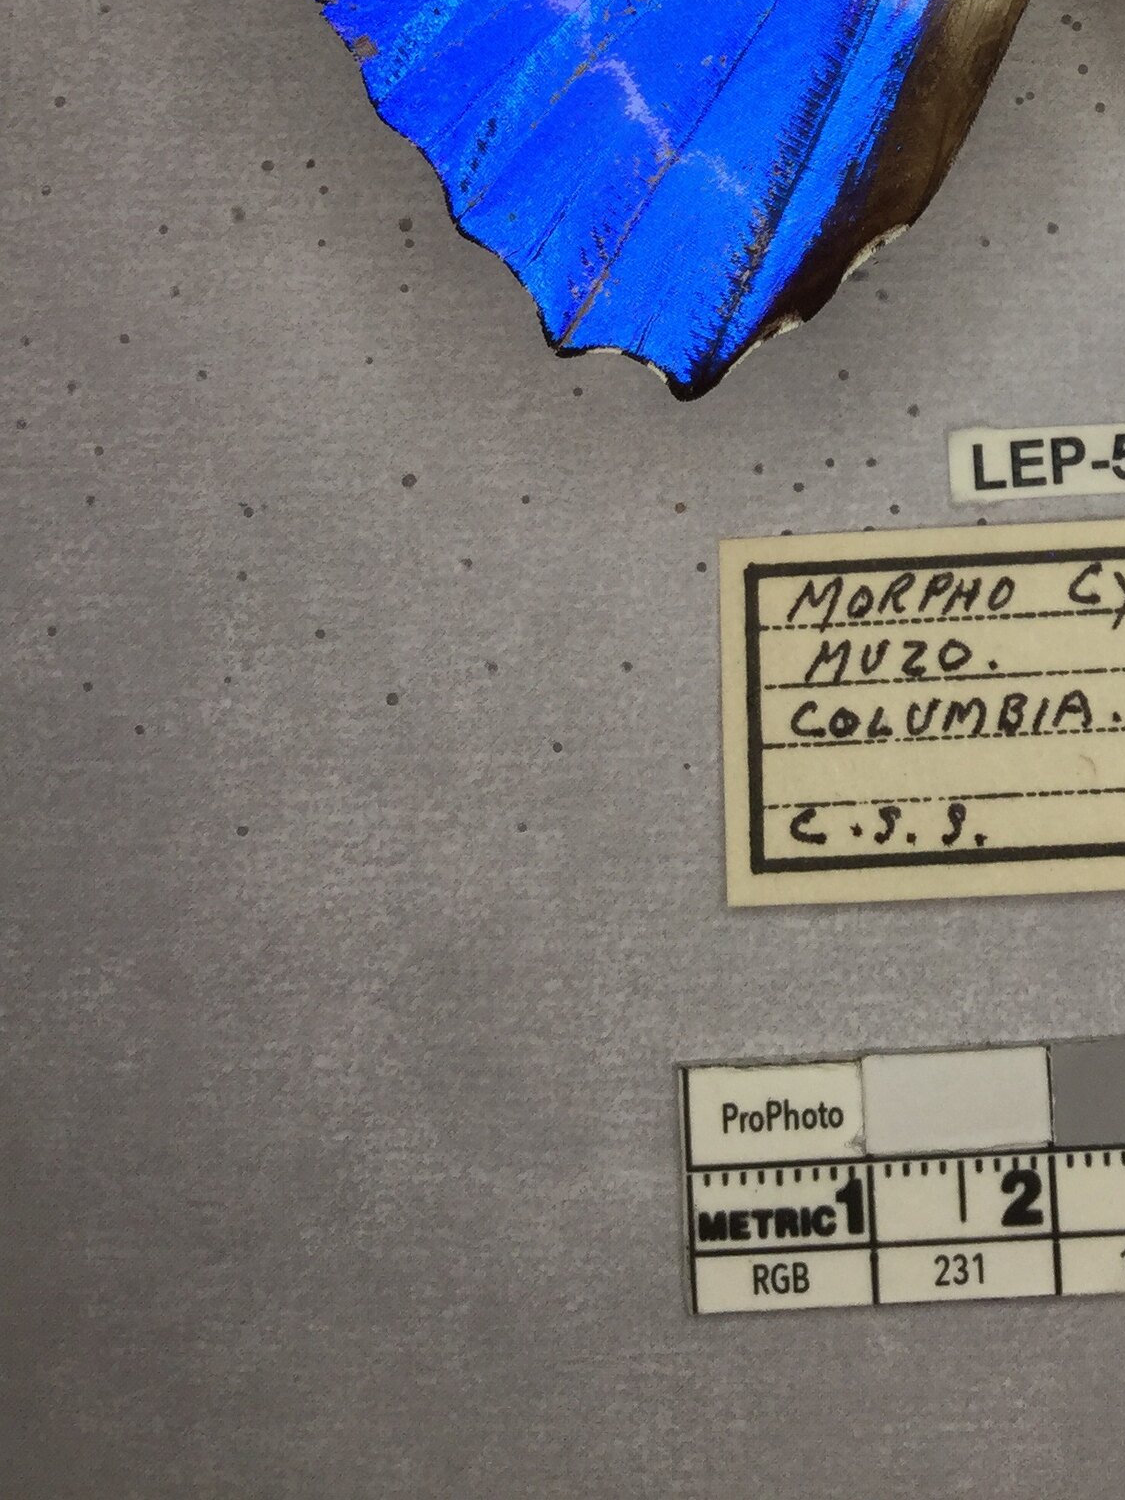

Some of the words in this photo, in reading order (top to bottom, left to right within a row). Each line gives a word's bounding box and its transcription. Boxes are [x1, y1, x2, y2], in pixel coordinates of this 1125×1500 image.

[786, 572, 1016, 633] MORPHO
[804, 638, 999, 684] MUZO.
[790, 690, 1122, 738] COLUMBIA.
[721, 1098, 845, 1134] ProPhoto
[698, 1204, 837, 1241] METRIC
[835, 1177, 865, 1235] 1
[1000, 1168, 1045, 1227] 2
[752, 1261, 811, 1296] RGB
[934, 1252, 985, 1287] 231
